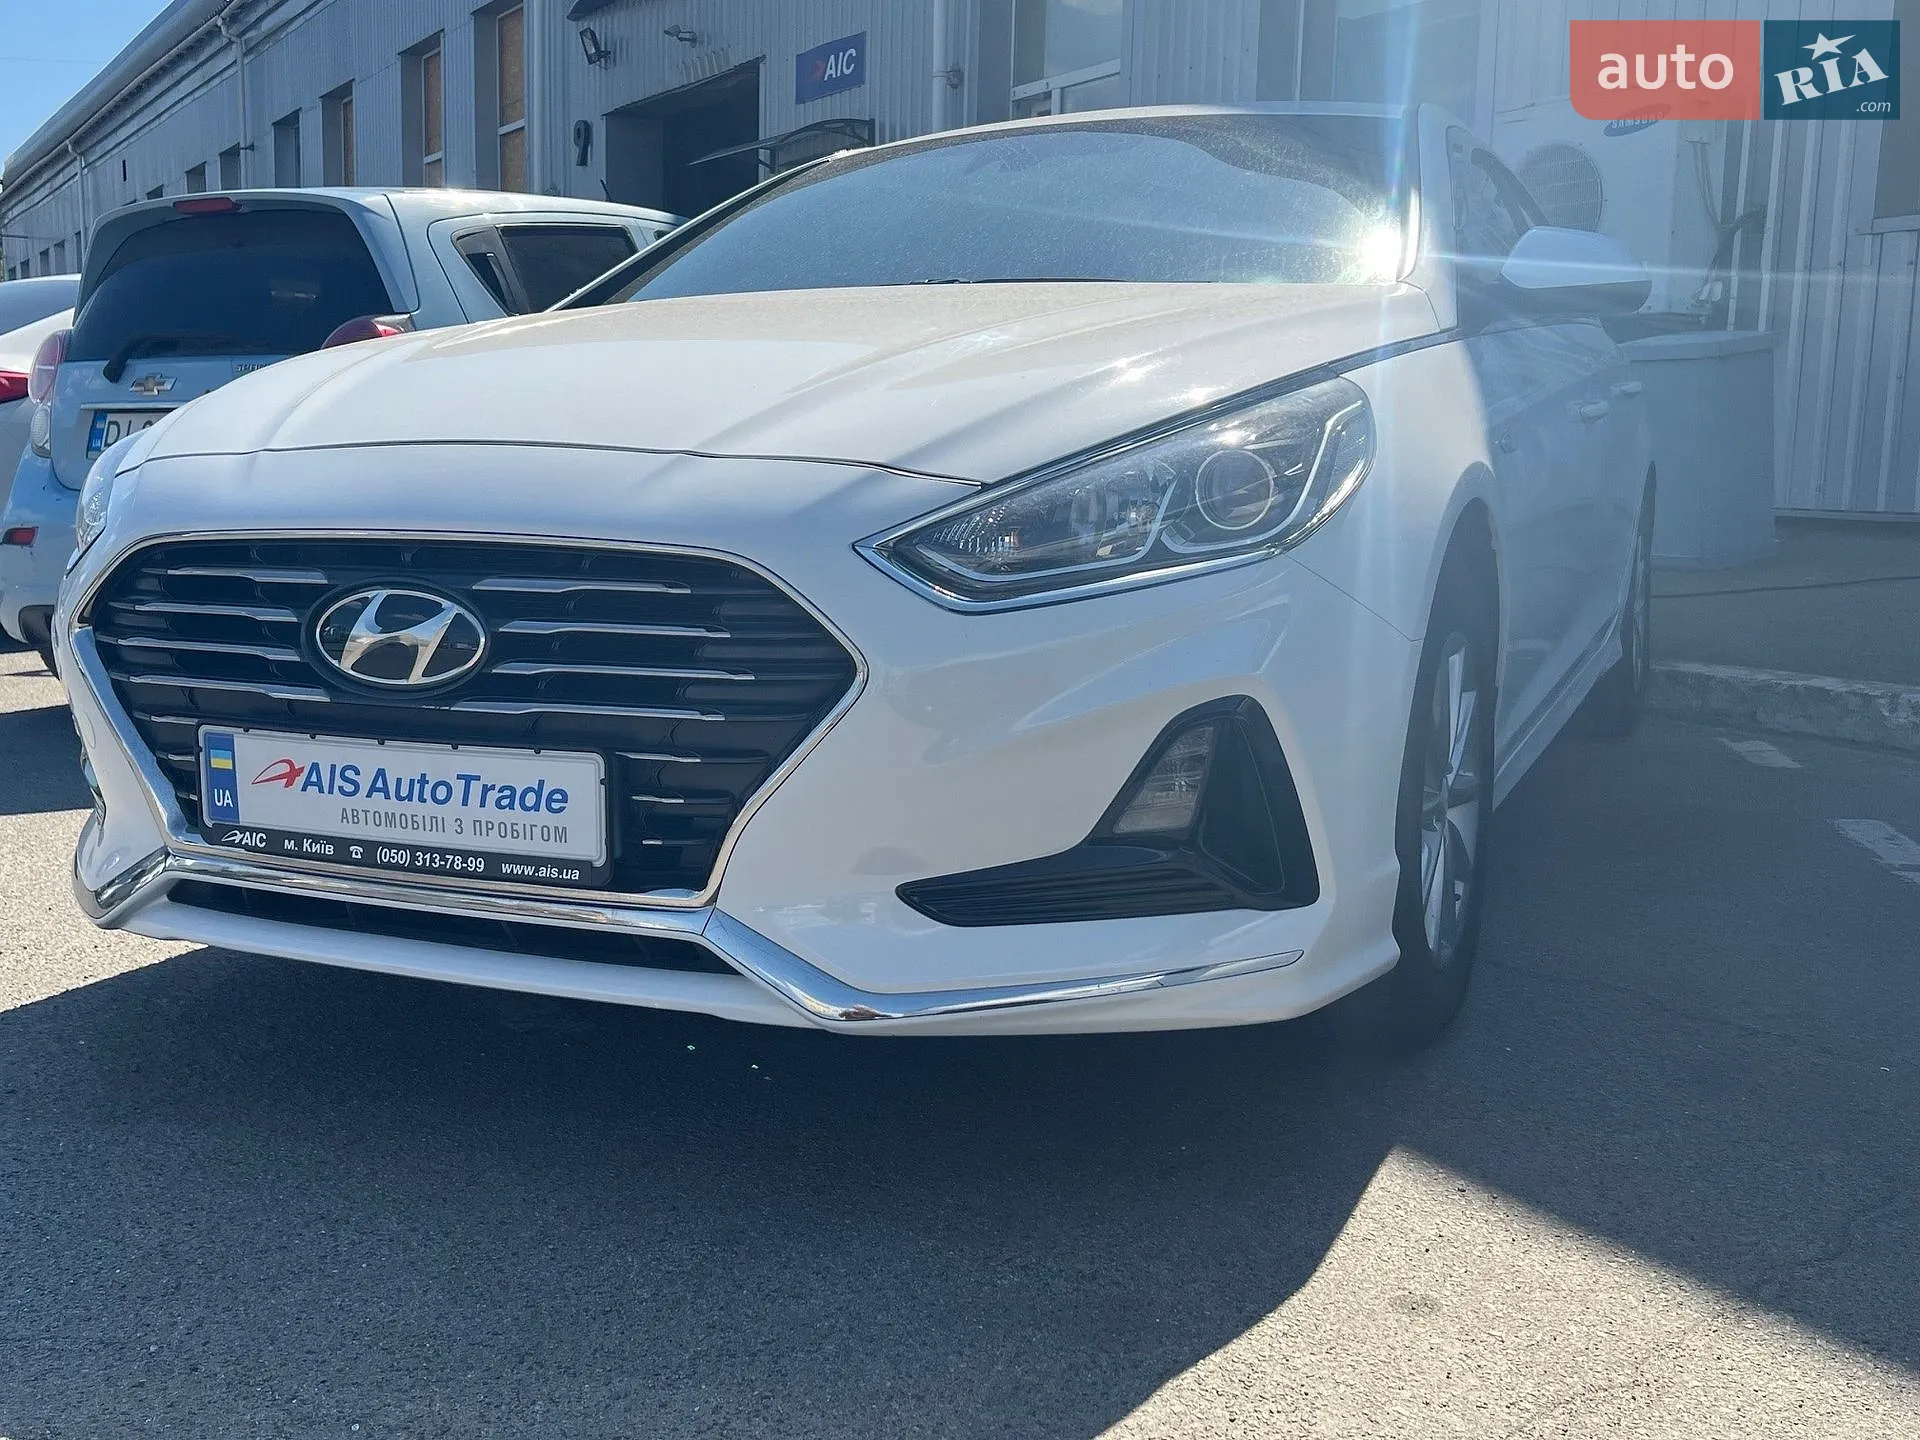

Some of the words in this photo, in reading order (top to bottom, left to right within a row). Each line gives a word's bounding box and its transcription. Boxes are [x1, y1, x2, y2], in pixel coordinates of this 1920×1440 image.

[214, 788, 233, 808] UA
[300, 761, 361, 798] AIS
[365, 766, 569, 814] AutoTrade
[340, 807, 447, 834] АВТОМОБІЛІ
[472, 819, 568, 844] ПРОБІГОМ
[284, 839, 299, 851] м.
[303, 838, 335, 856] Київ
[376, 845, 411, 868] (050)
[415, 851, 485, 873] 313-78-99
[501, 861, 580, 881] www.ais.ua
